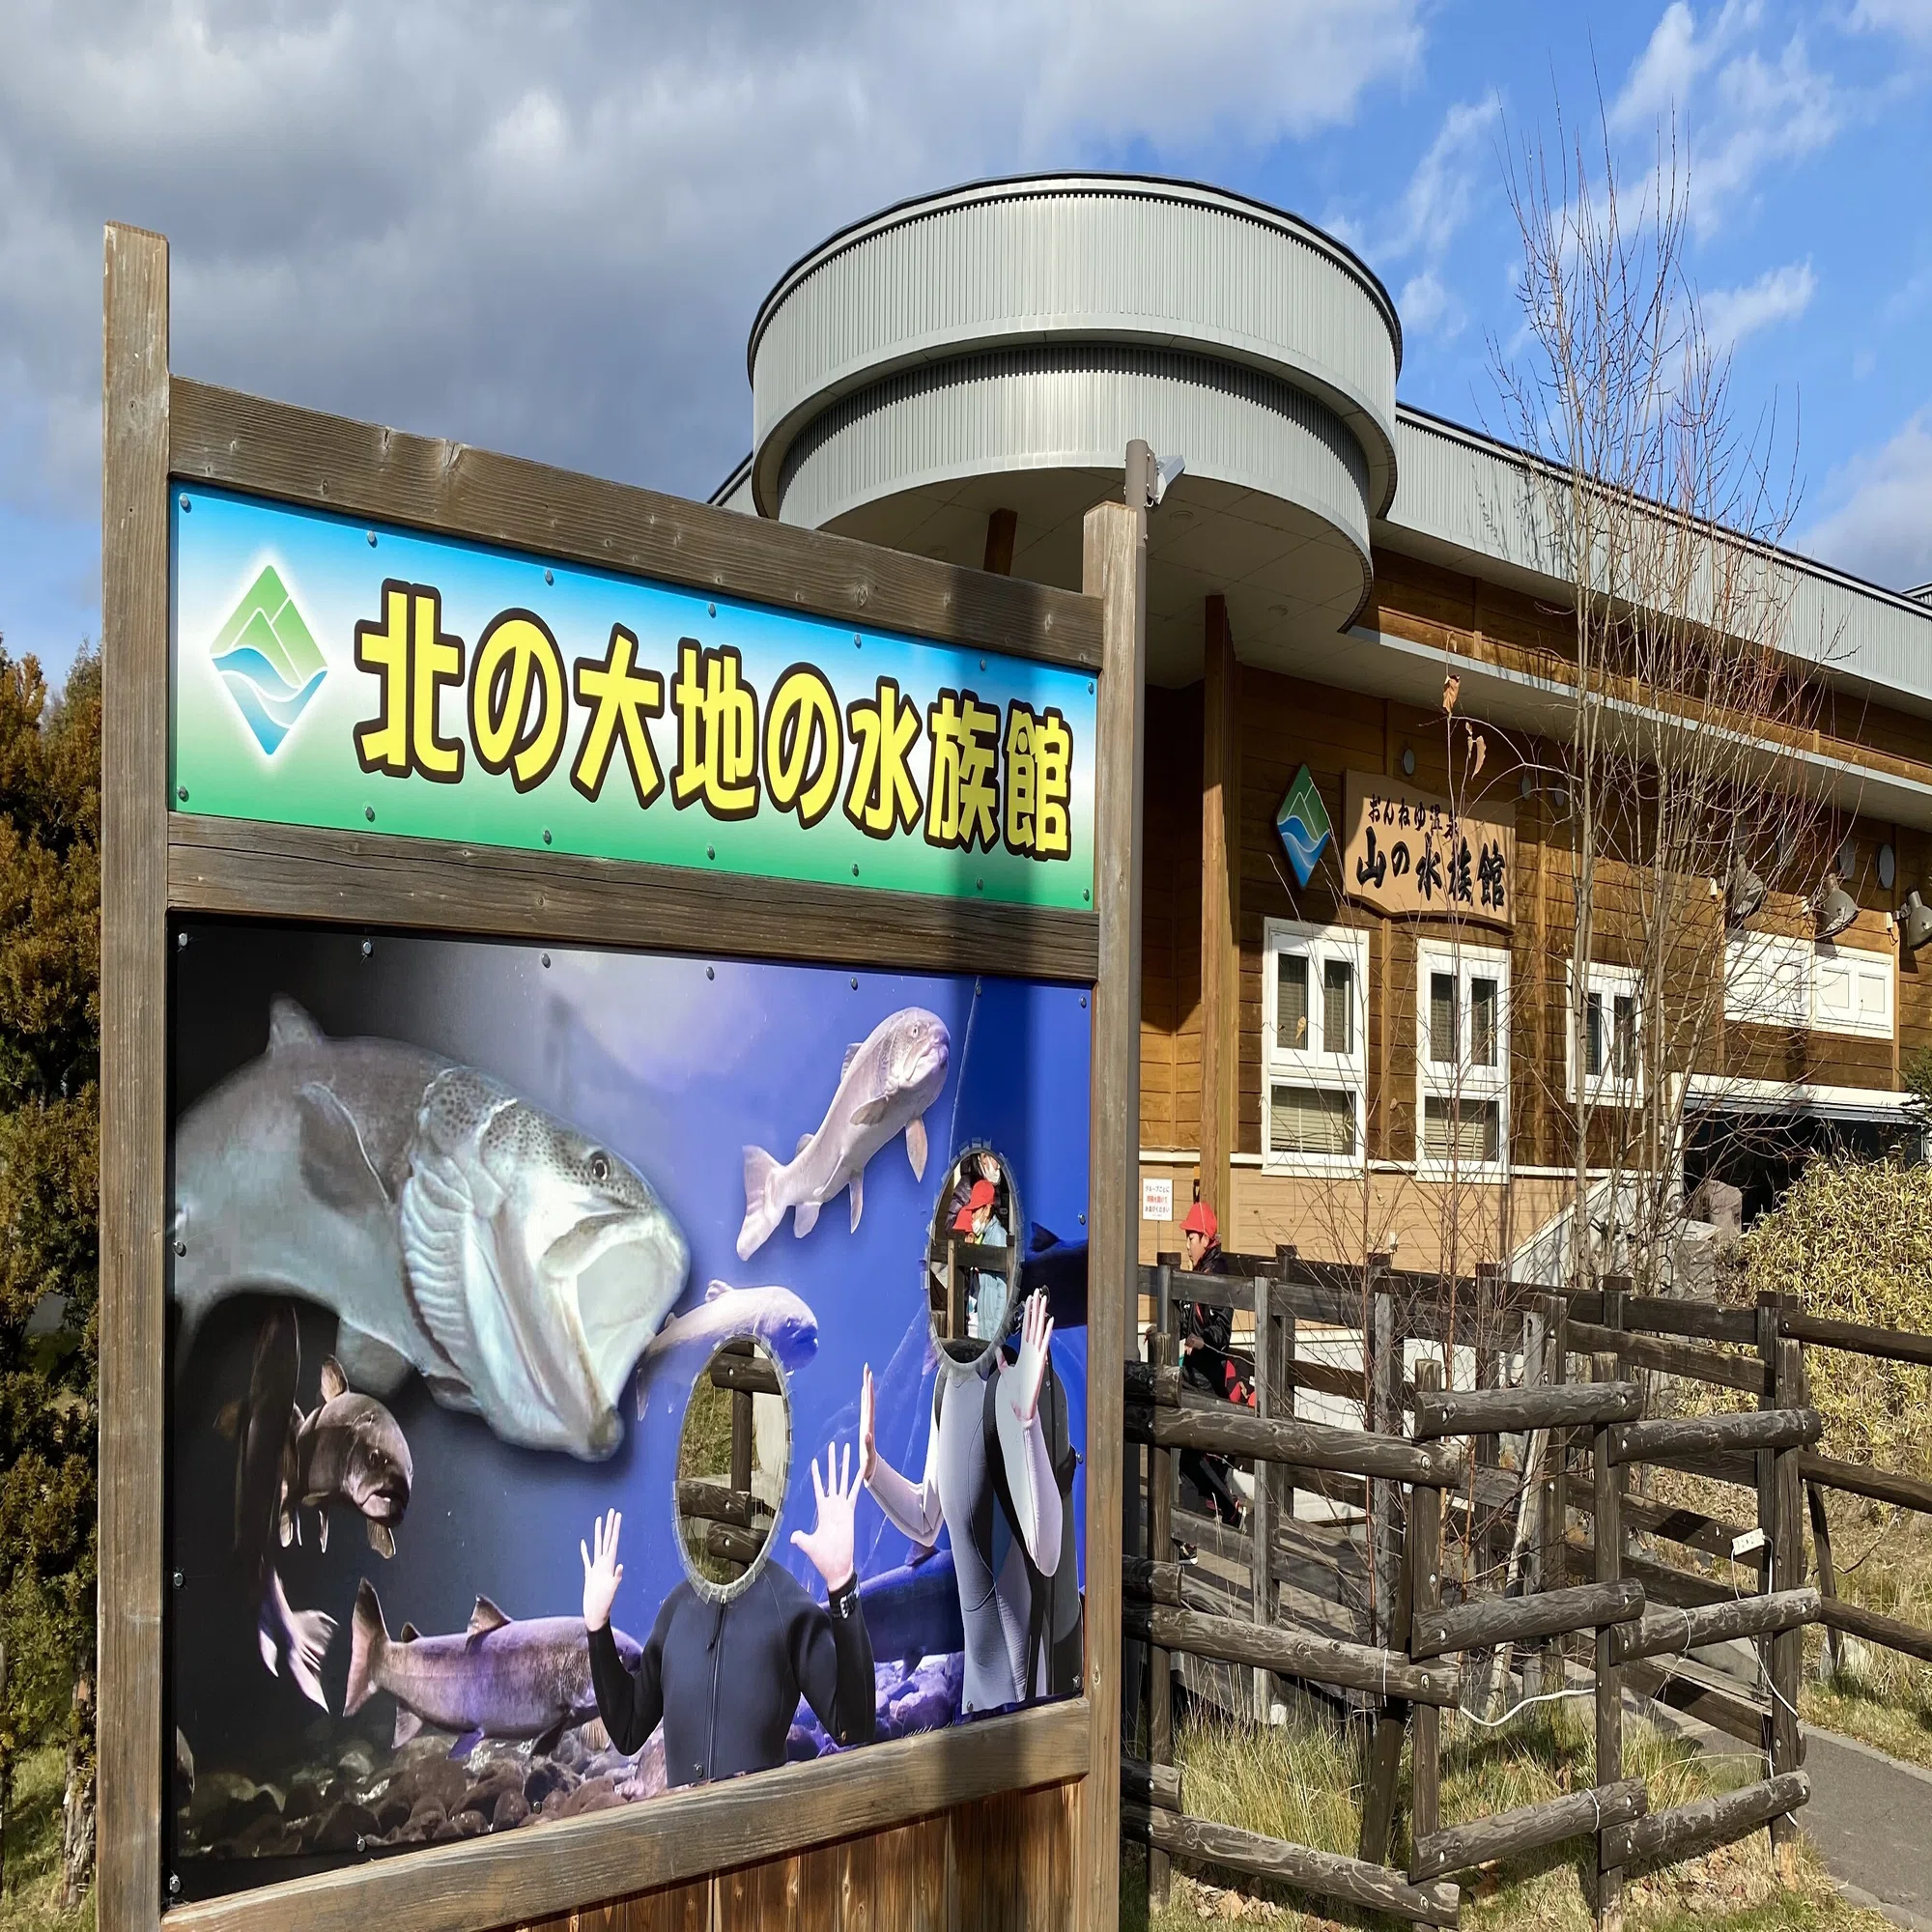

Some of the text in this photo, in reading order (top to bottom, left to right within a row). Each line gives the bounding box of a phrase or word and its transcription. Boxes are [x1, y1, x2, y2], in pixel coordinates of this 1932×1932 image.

[353, 578, 1071, 862] 北の大地の水族館
[1356, 825, 1505, 912] 山の水族館
